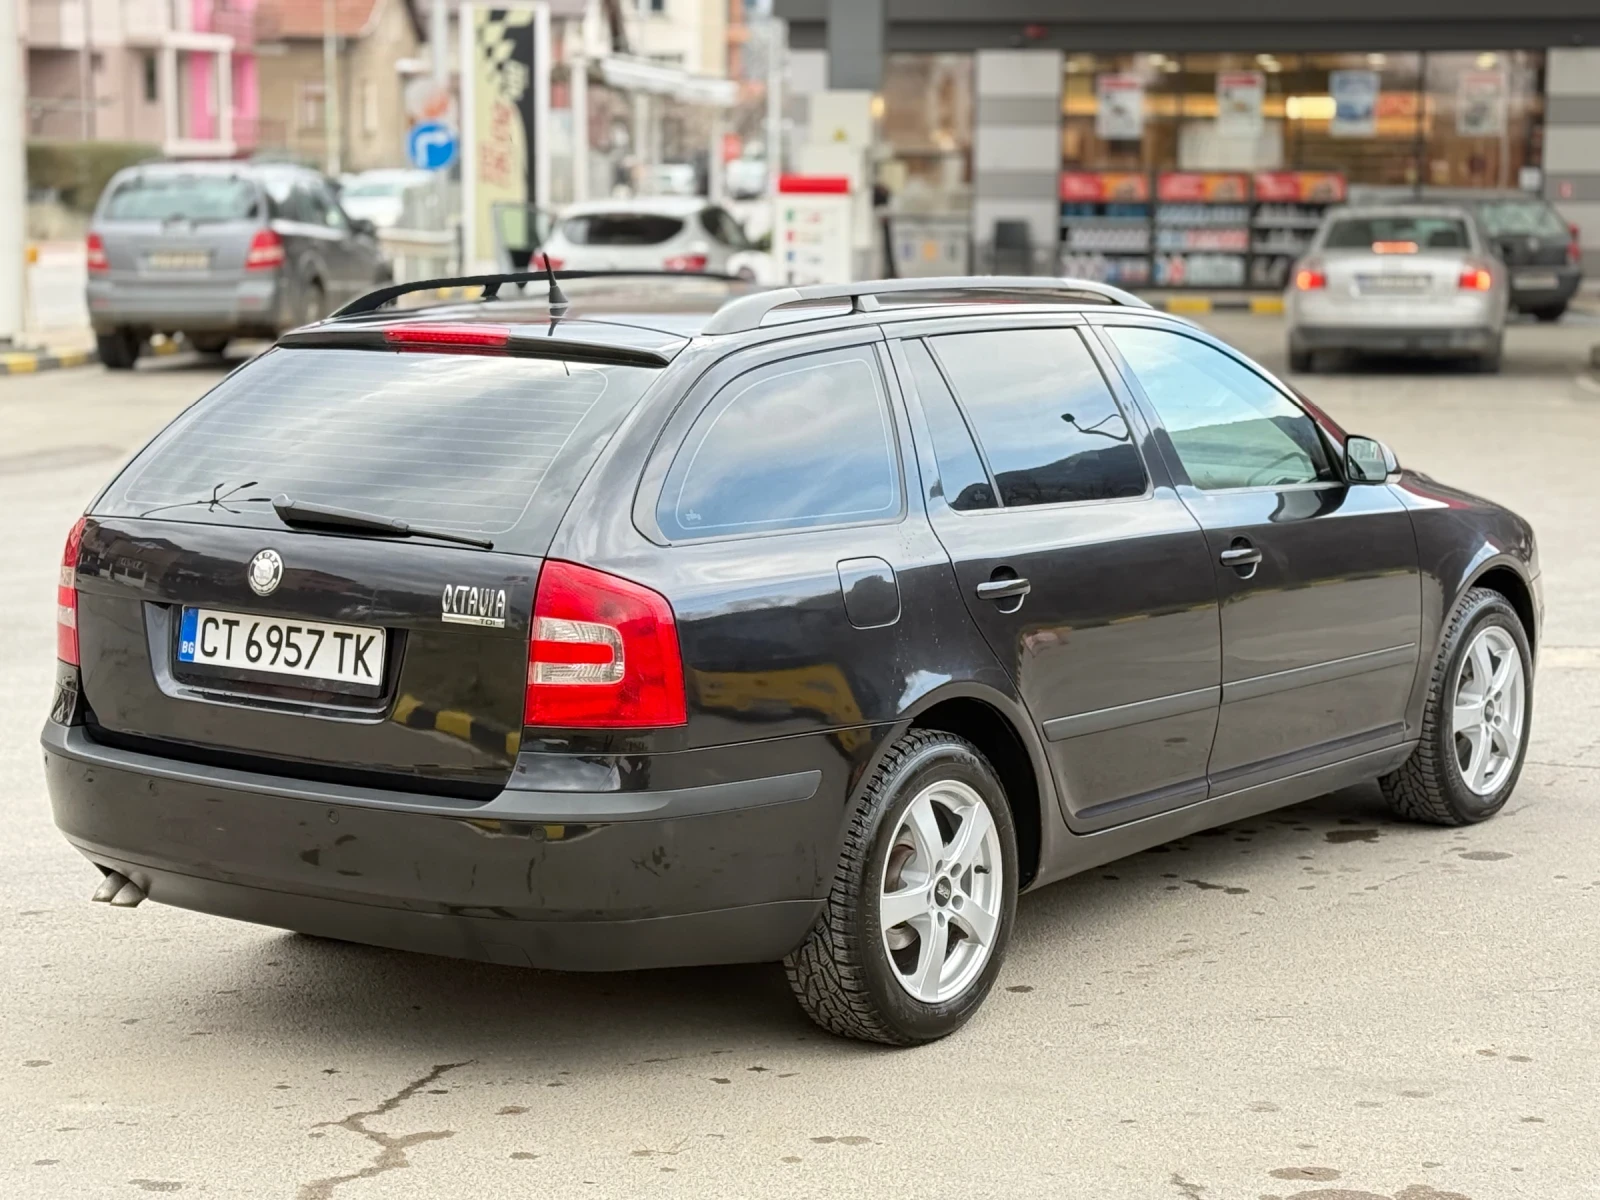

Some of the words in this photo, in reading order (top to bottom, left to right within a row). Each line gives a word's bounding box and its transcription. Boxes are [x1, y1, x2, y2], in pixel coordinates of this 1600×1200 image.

[441, 584, 506, 618] OCTAVIA
[182, 641, 195, 655] BG
[201, 617, 240, 661] CT
[245, 622, 325, 670] 6957
[333, 632, 376, 678] TK
